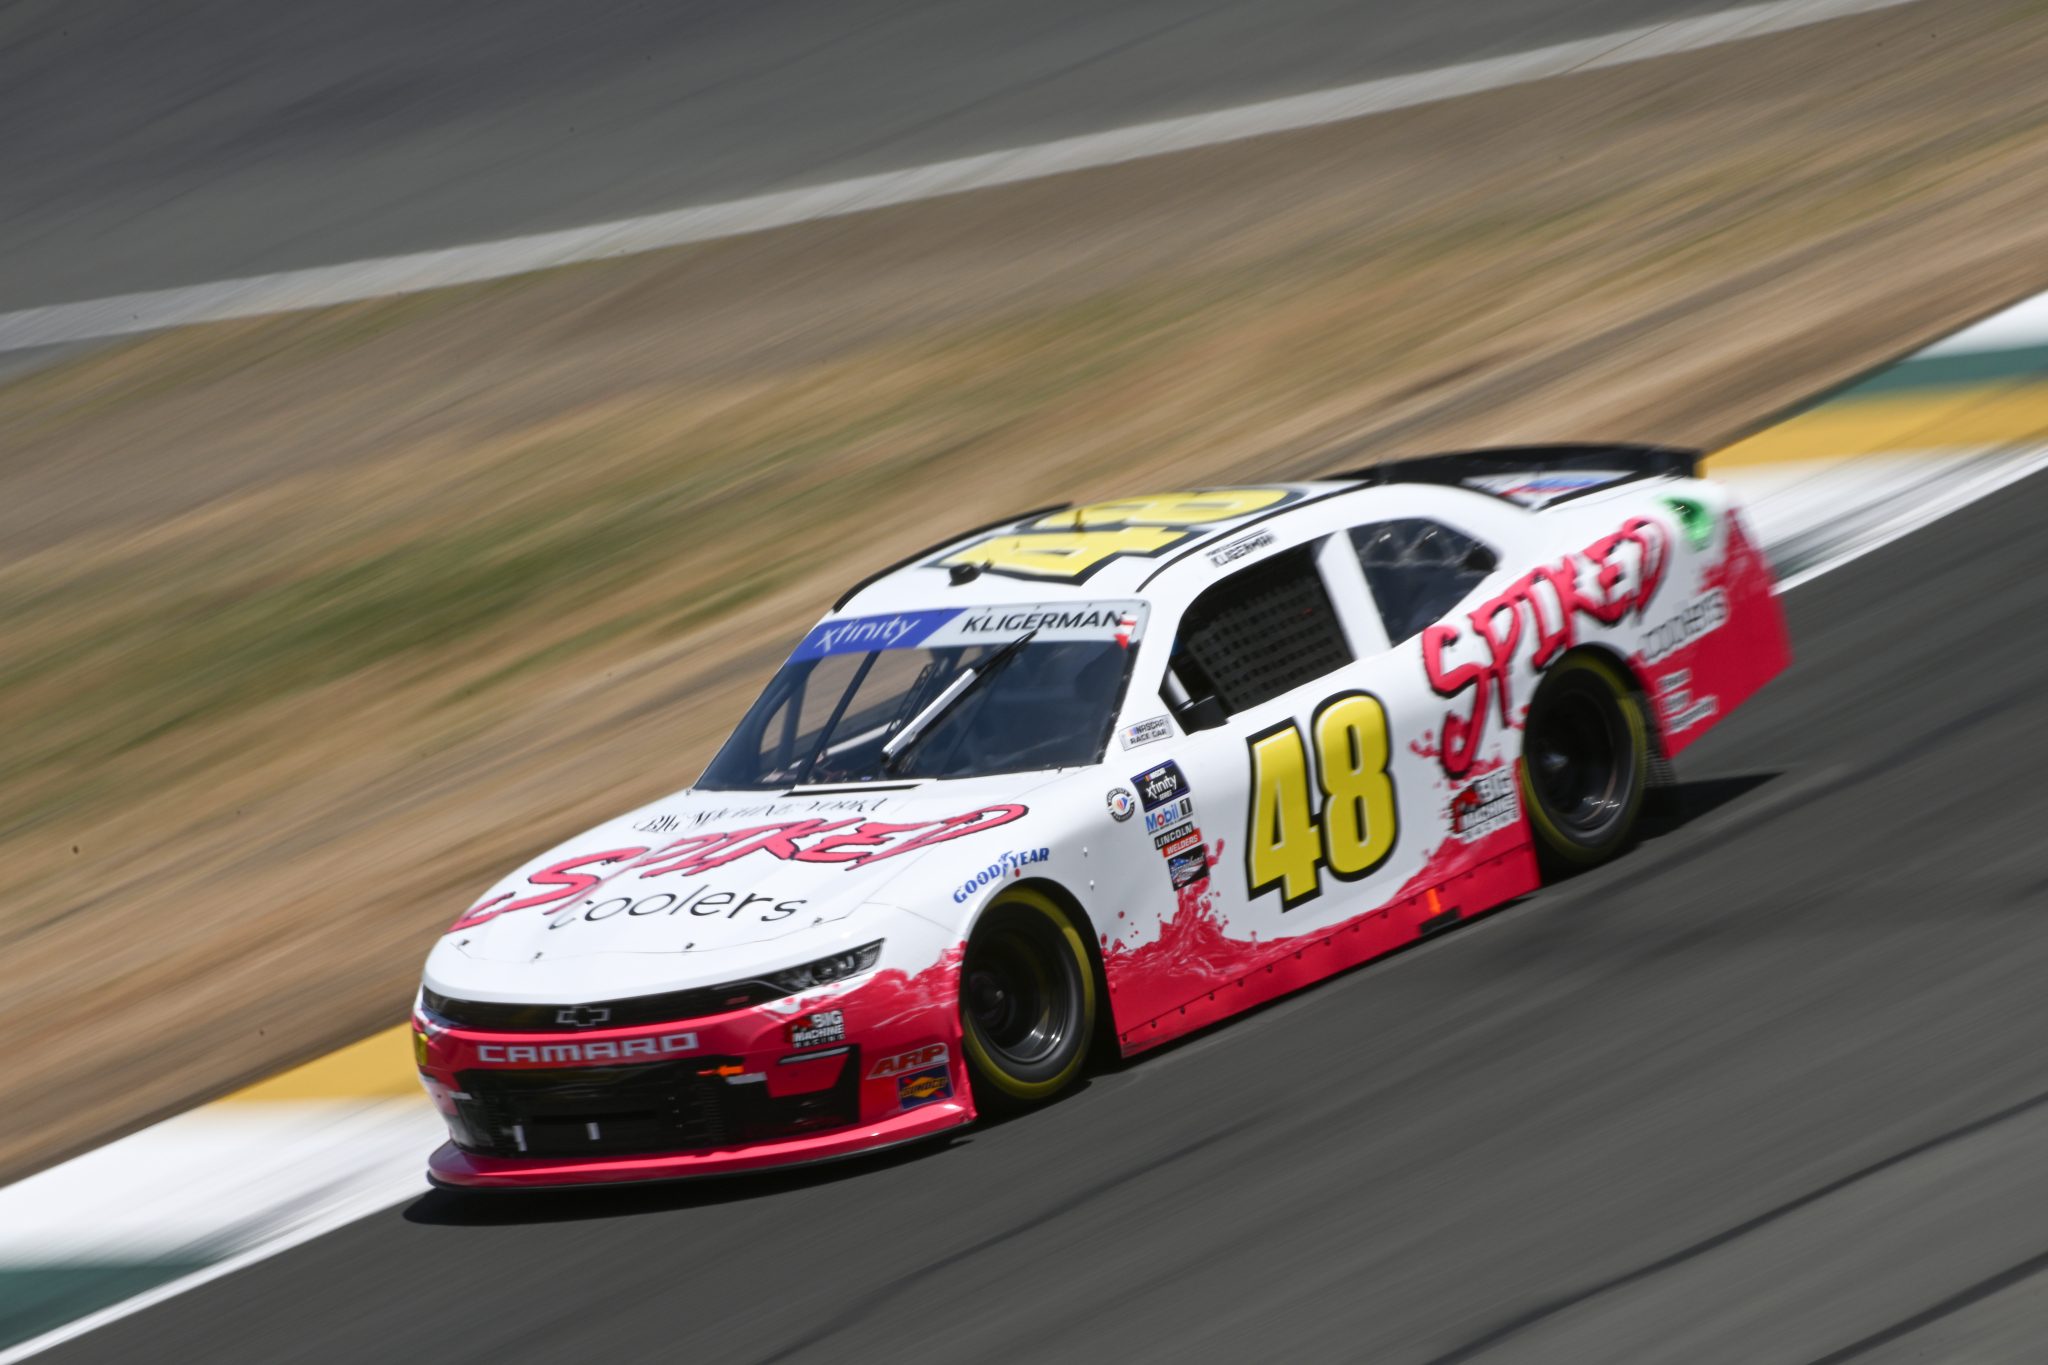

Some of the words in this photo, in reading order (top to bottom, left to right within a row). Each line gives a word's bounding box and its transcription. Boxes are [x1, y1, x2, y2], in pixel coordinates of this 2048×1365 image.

[925, 486, 1308, 585] 48
[815, 619, 921, 652] xfinity
[961, 610, 1127, 634] KLIGERMAN
[1422, 516, 1671, 778] SPIKED
[1130, 733, 1149, 745] RACE
[1152, 728, 1167, 738] CAR
[1145, 774, 1177, 799] xfinity
[1246, 689, 1400, 912] 48
[1145, 803, 1180, 832] Mobil
[1156, 822, 1193, 847] LINCOLN
[1167, 834, 1199, 855] WELDERS
[953, 847, 1050, 904] GOODYEAR
[548, 884, 808, 930] coolers
[793, 1024, 844, 1042] MACHINE
[811, 1010, 844, 1028] BIG
[478, 1032, 699, 1062] CAMARO
[873, 1045, 944, 1075] ARP
